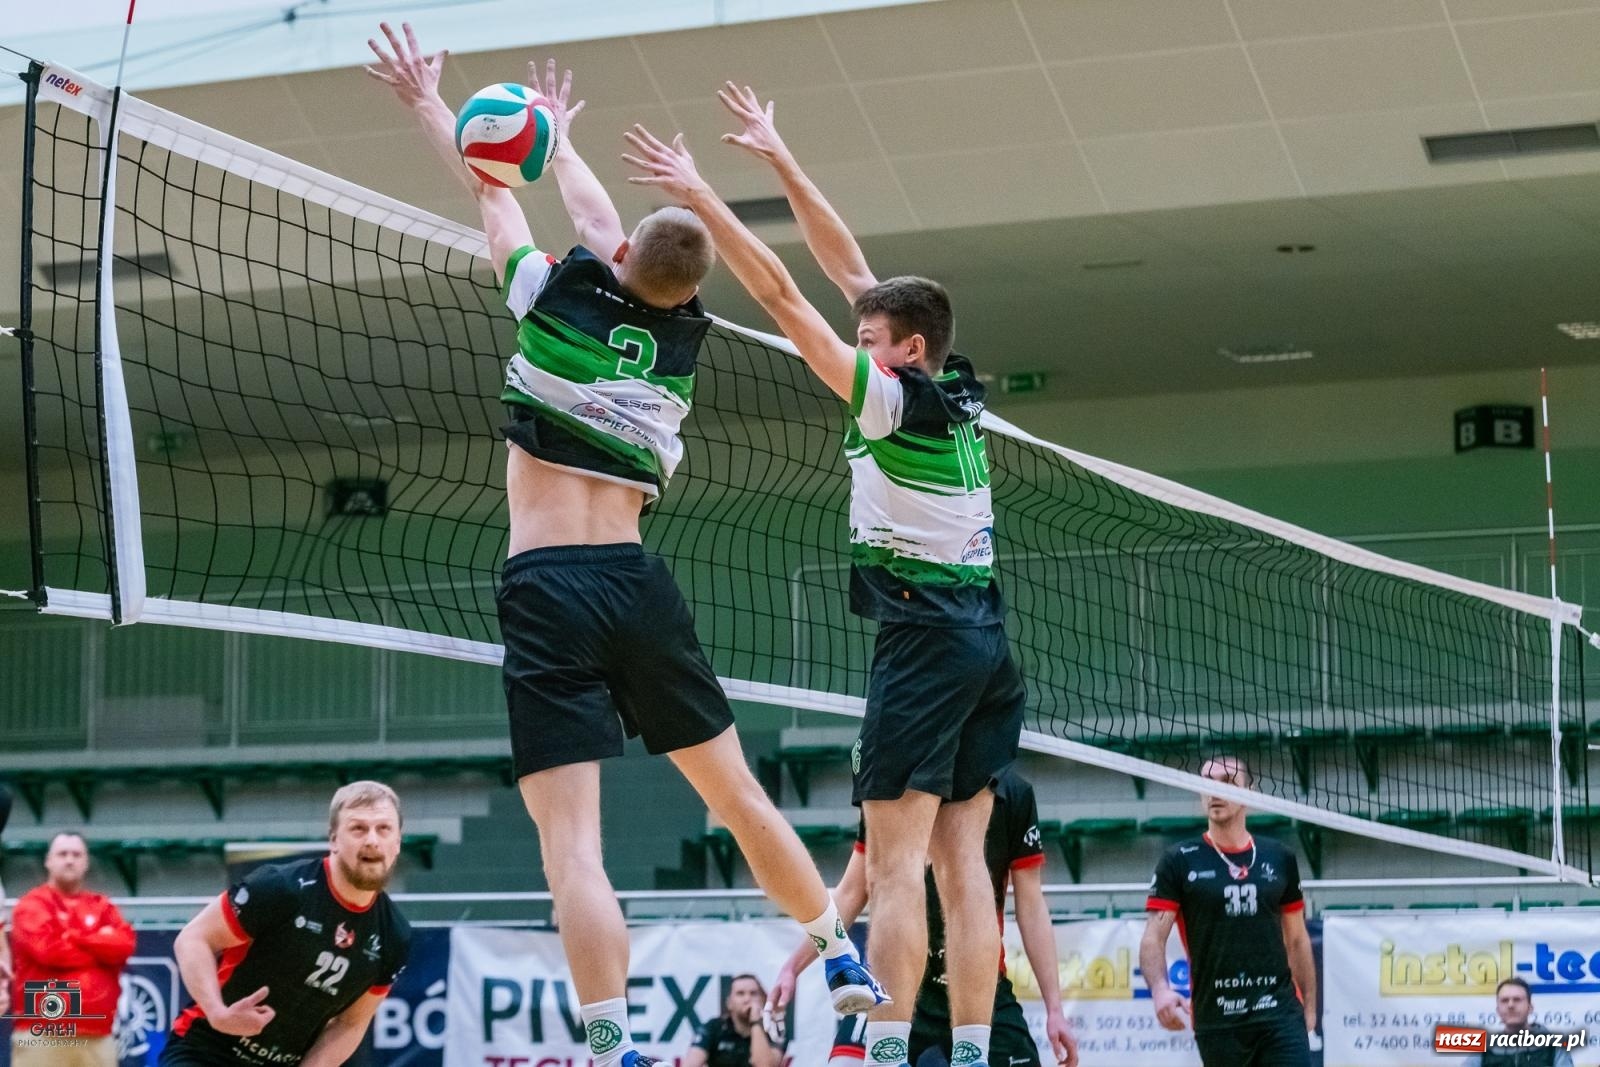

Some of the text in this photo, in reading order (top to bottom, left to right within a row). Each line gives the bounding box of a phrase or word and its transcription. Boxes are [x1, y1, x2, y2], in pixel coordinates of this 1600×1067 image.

[46, 73, 82, 96] netex
[1494, 419, 1522, 444] B
[1224, 883, 1258, 917] 33
[304, 951, 350, 996] 22
[1370, 1013, 1386, 1028] 32
[1391, 1013, 1419, 1028] 414
[1479, 1012, 1498, 1025] 50
[1354, 1034, 1409, 1049] 47-400
